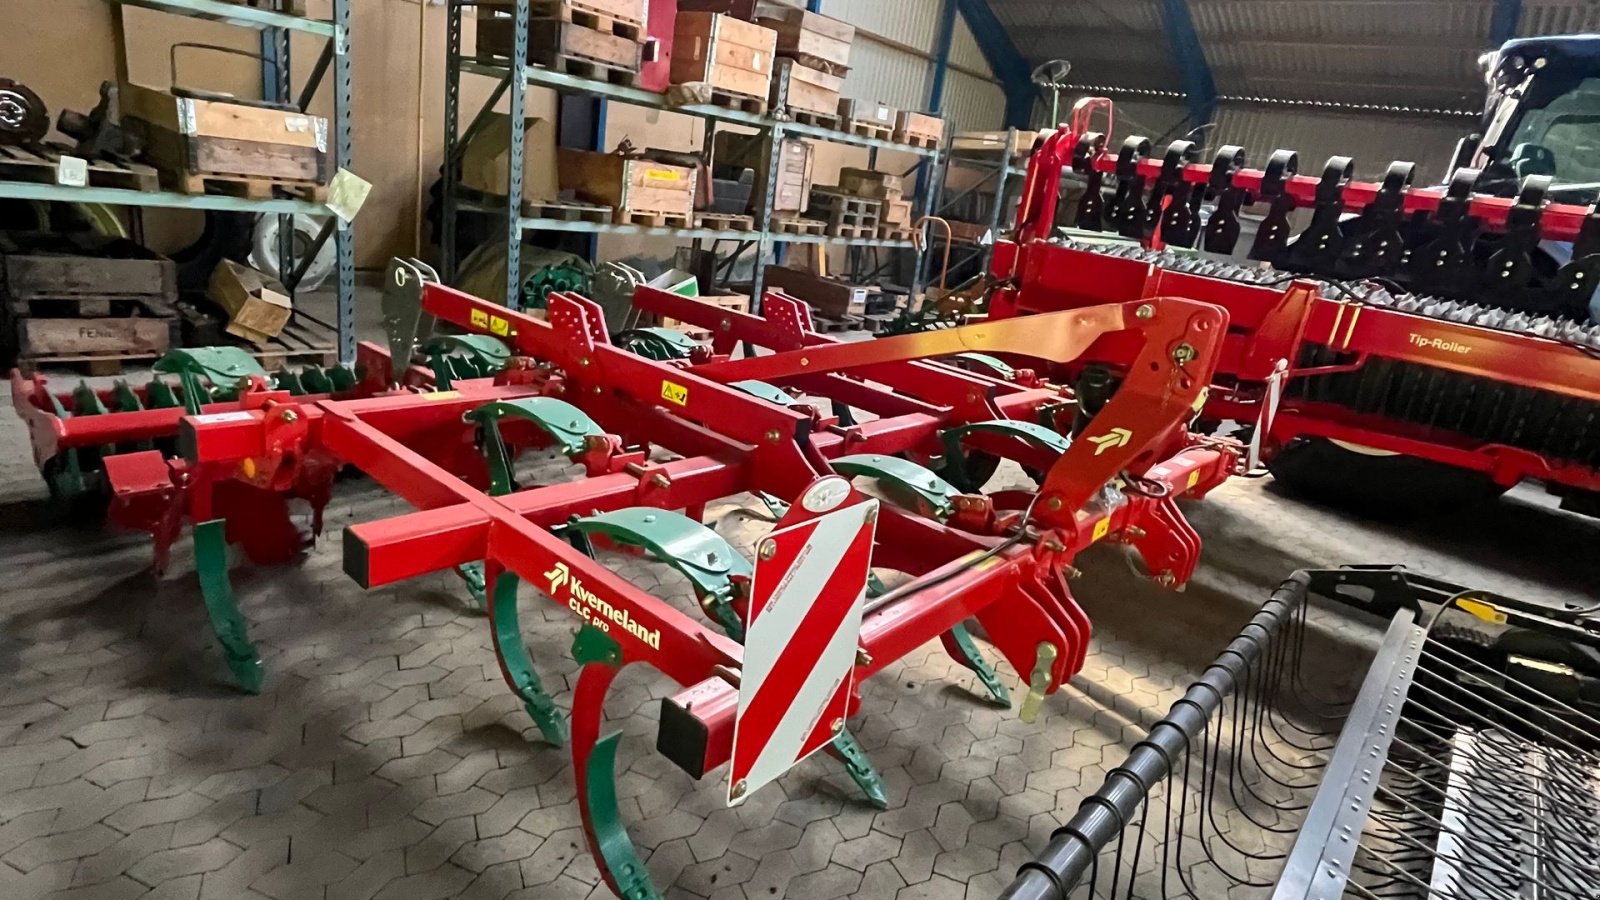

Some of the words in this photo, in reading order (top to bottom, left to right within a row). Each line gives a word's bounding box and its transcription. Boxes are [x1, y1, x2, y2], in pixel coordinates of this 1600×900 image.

[1409, 333, 1472, 354] Tip-Roller
[568, 597, 591, 620] CLC
[592, 617, 610, 632] pro
[570, 575, 661, 651] Kverneland
